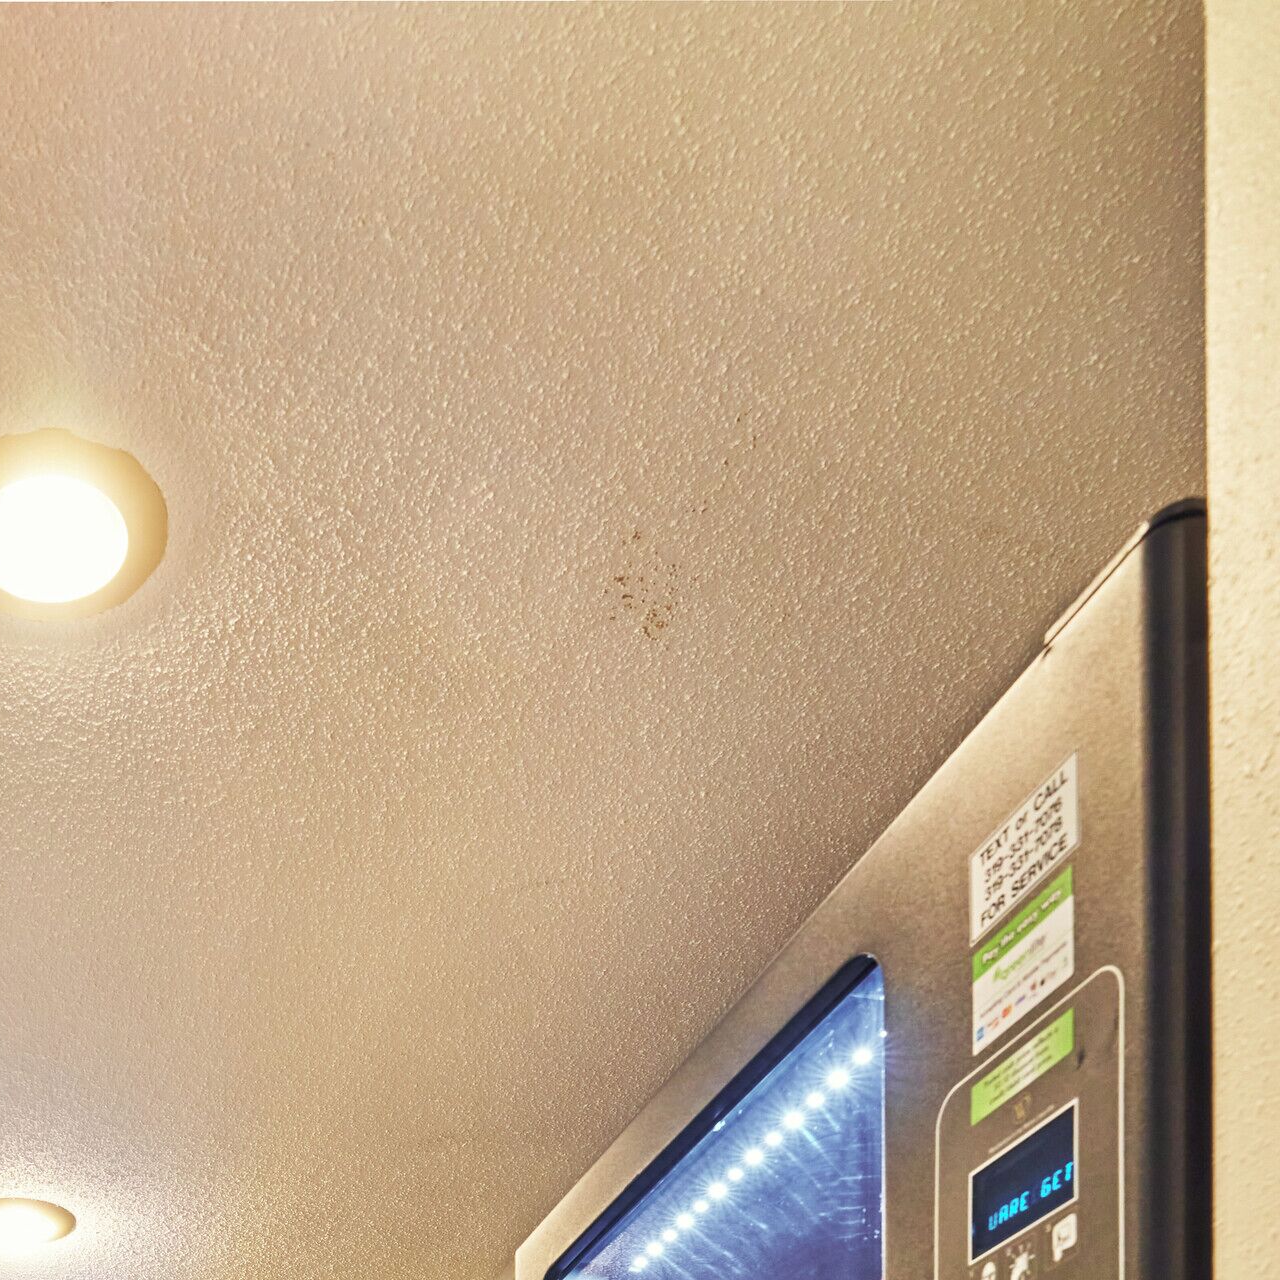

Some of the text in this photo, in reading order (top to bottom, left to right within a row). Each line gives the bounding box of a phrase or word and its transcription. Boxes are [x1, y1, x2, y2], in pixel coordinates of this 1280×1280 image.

[980, 826, 1010, 865] TEXT
[1034, 770, 1068, 811] CALL
[981, 833, 1068, 927] FOR SERVICE
